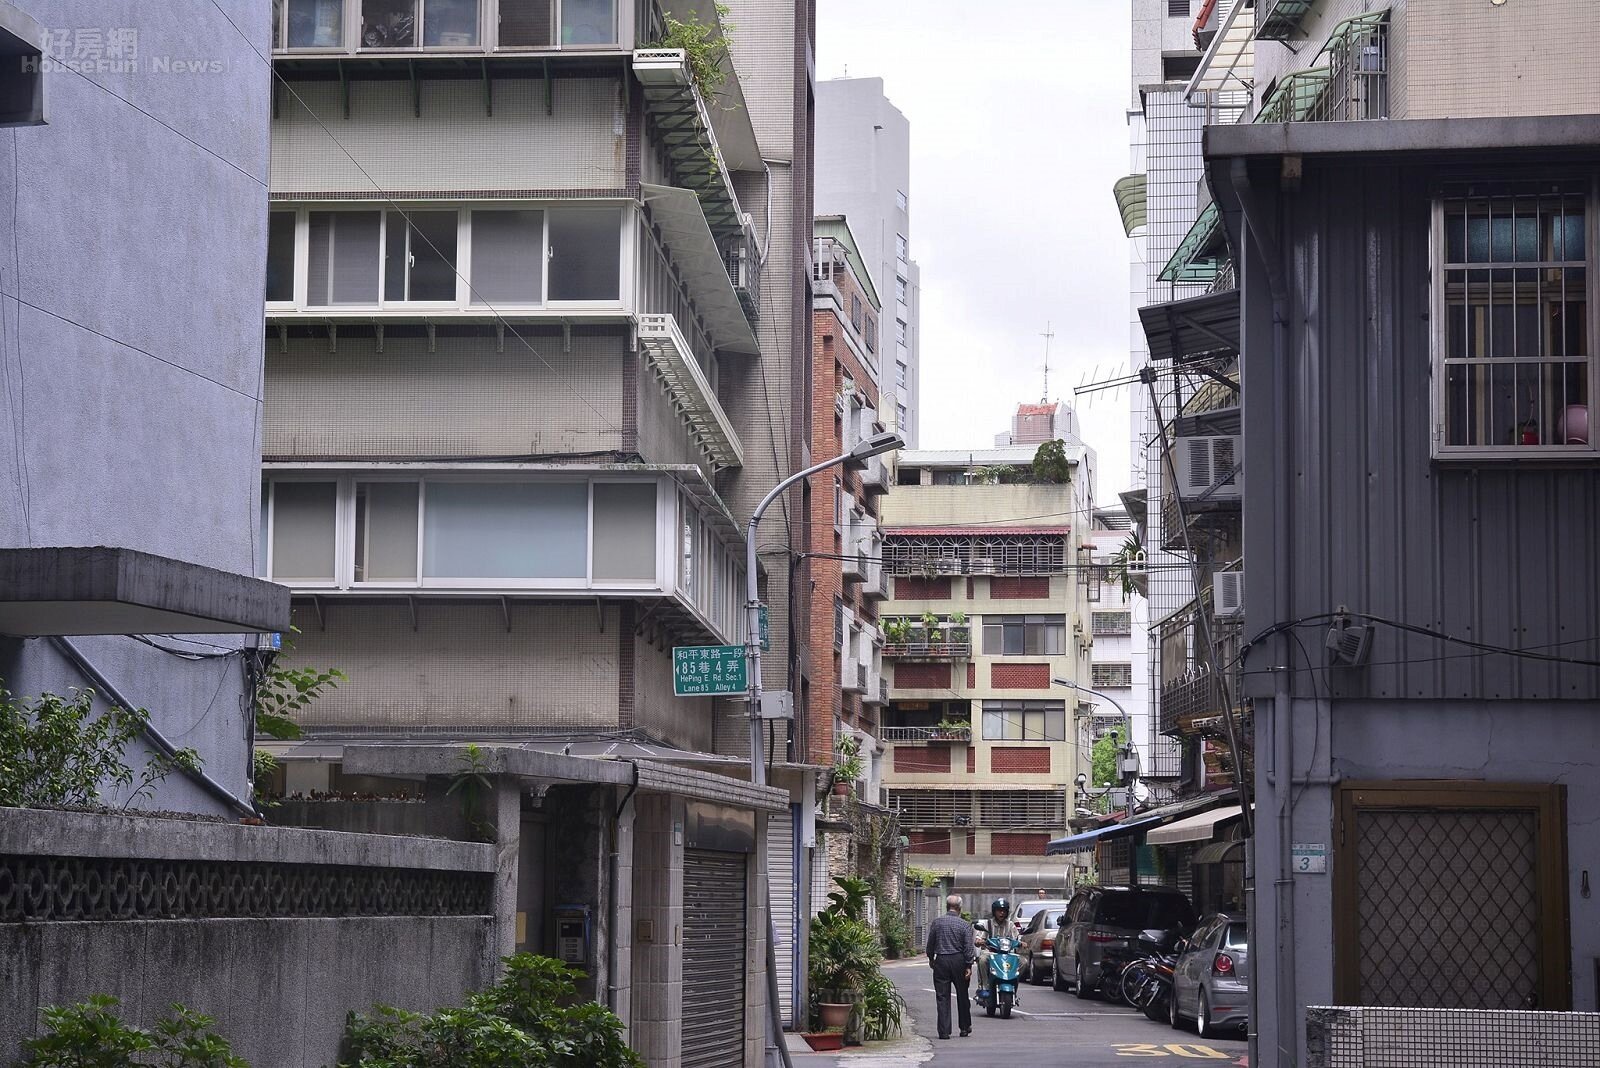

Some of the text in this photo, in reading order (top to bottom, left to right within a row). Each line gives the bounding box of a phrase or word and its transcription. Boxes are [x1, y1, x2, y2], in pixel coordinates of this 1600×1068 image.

[677, 648, 743, 660] 和平東路一段
[680, 674, 702, 683] HePing
[683, 684, 700, 692] Lane
[715, 683, 730, 692] Alley
[1300, 857, 1310, 871] 3
